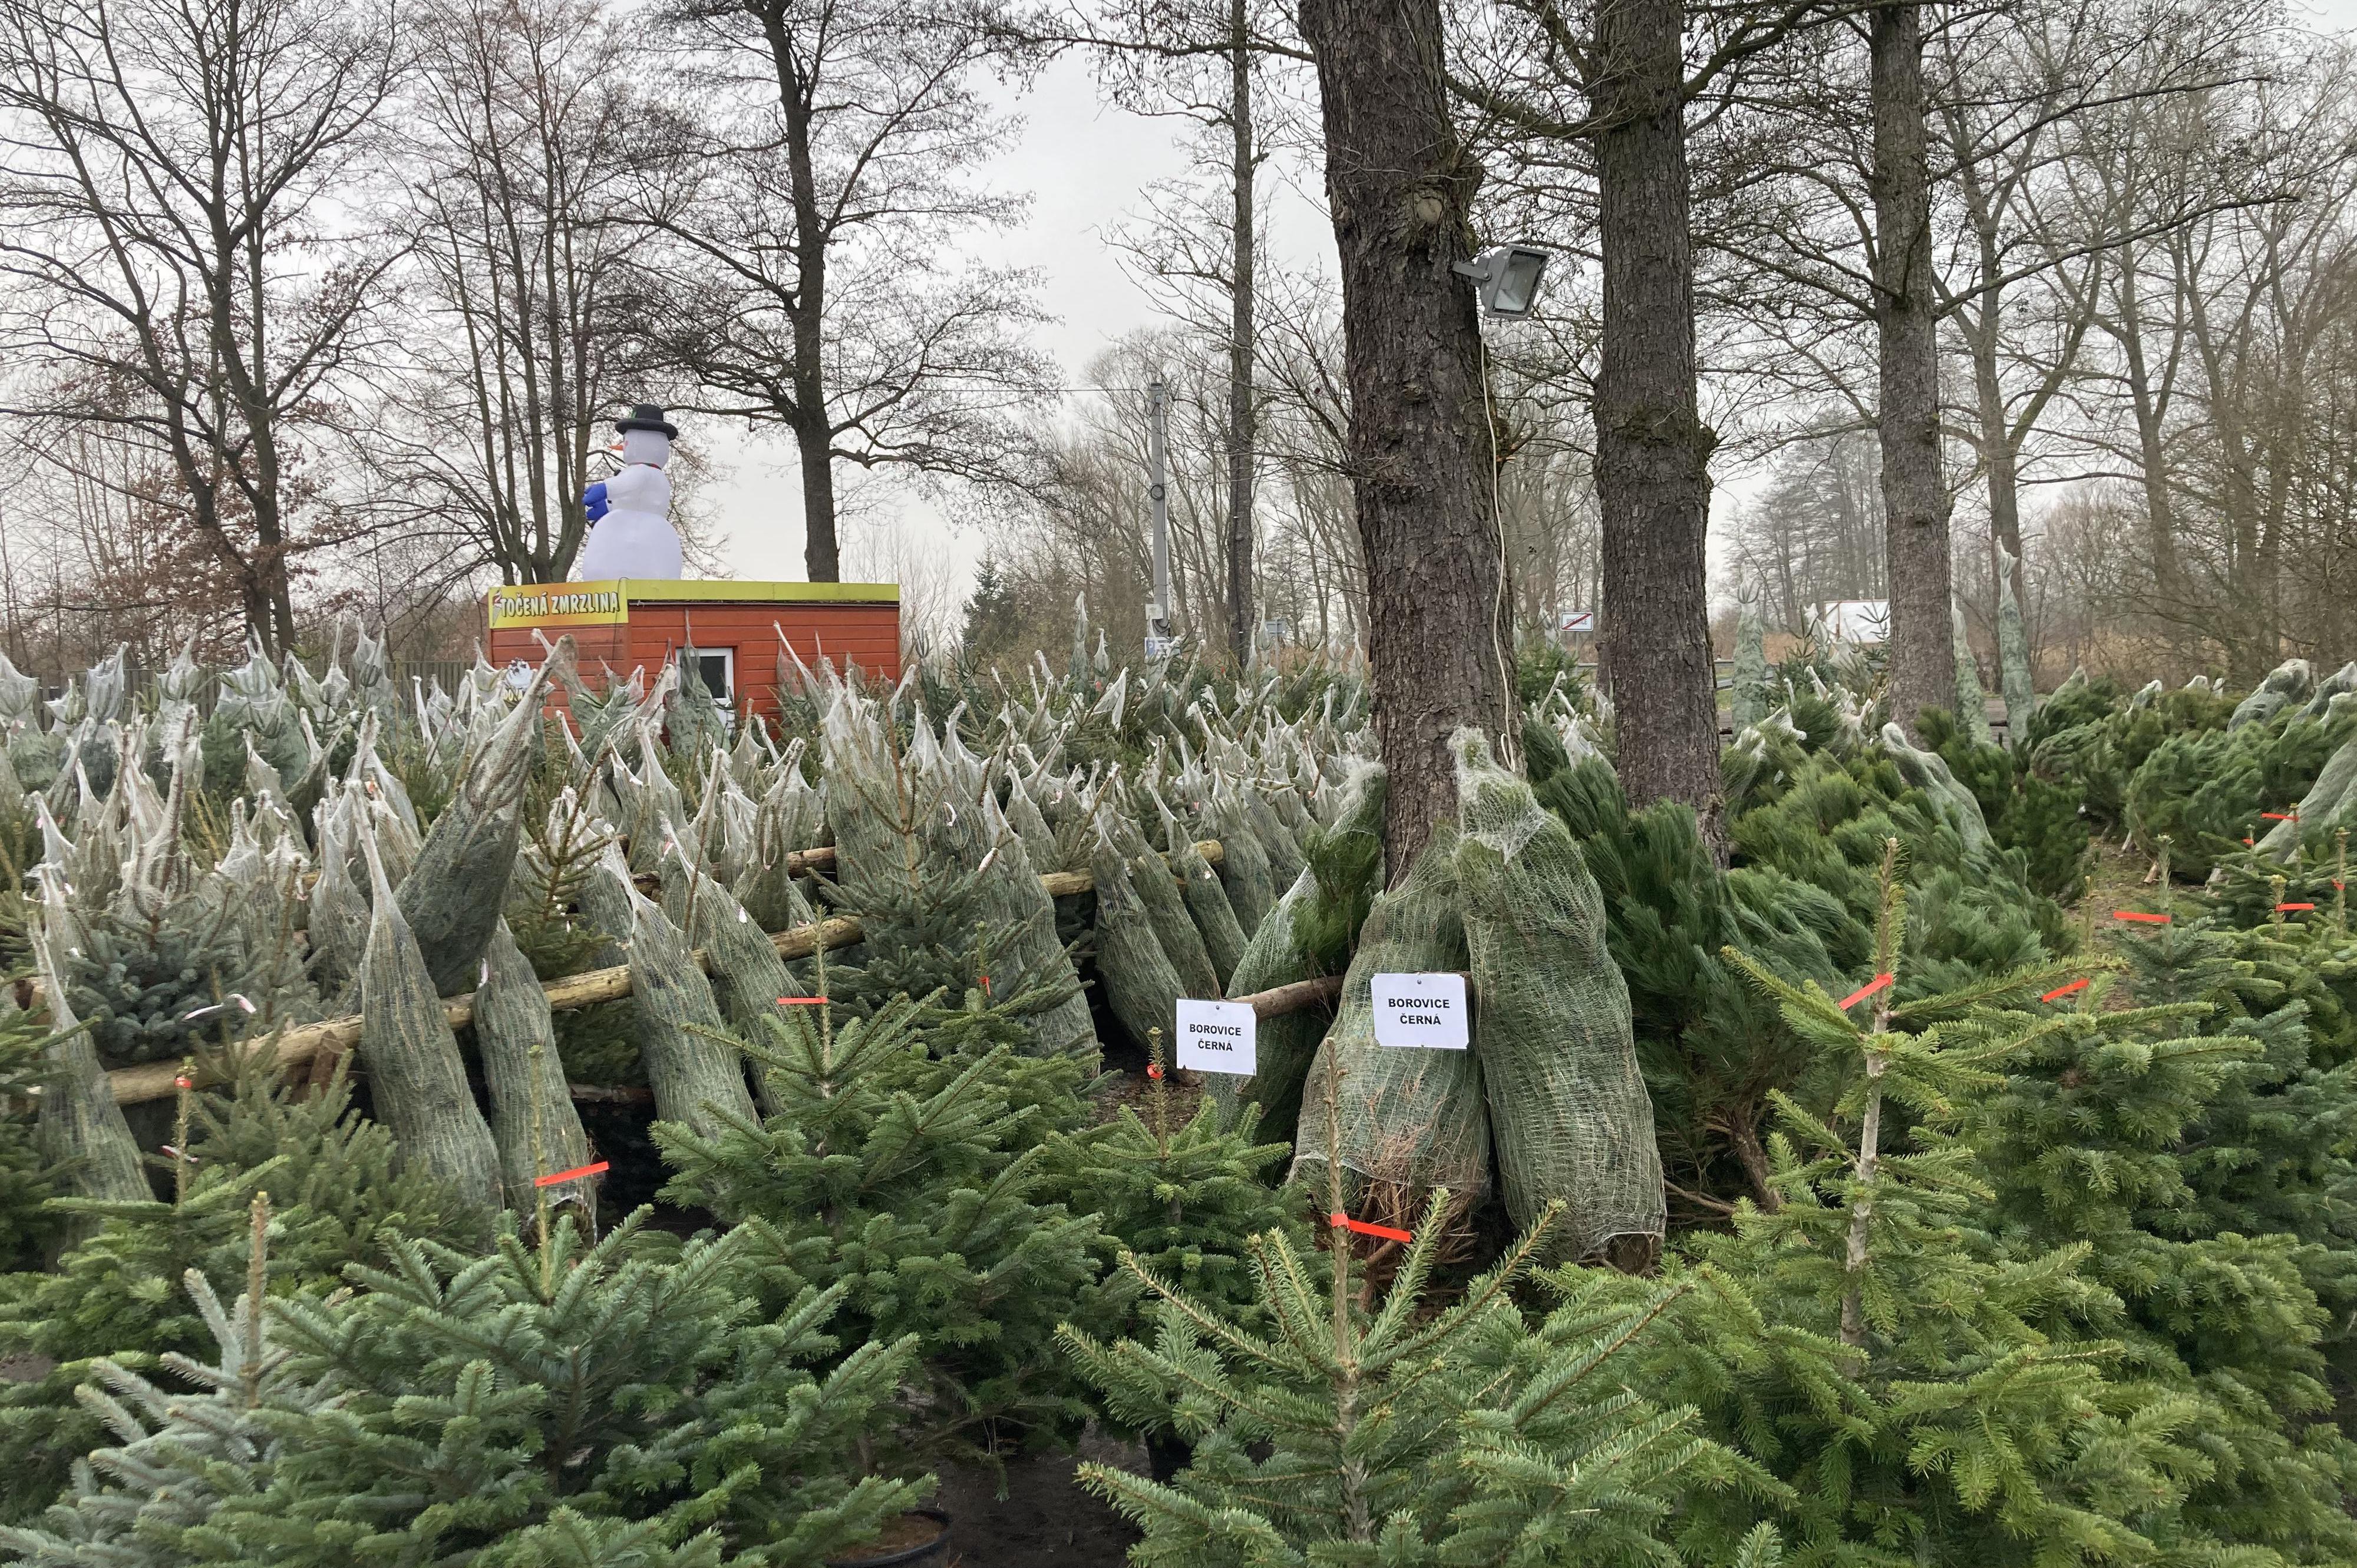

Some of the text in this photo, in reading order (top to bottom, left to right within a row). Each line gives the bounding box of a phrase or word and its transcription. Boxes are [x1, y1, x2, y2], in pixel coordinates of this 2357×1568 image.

[500, 592, 619, 618] TOČENÁ ZMRZLINA
[1388, 998, 1450, 1008] BOROVICE
[1399, 1013, 1441, 1025] ČERNÁ
[1190, 1024, 1242, 1036] BOROVICE
[1198, 1038, 1233, 1051] ČERNÁ
